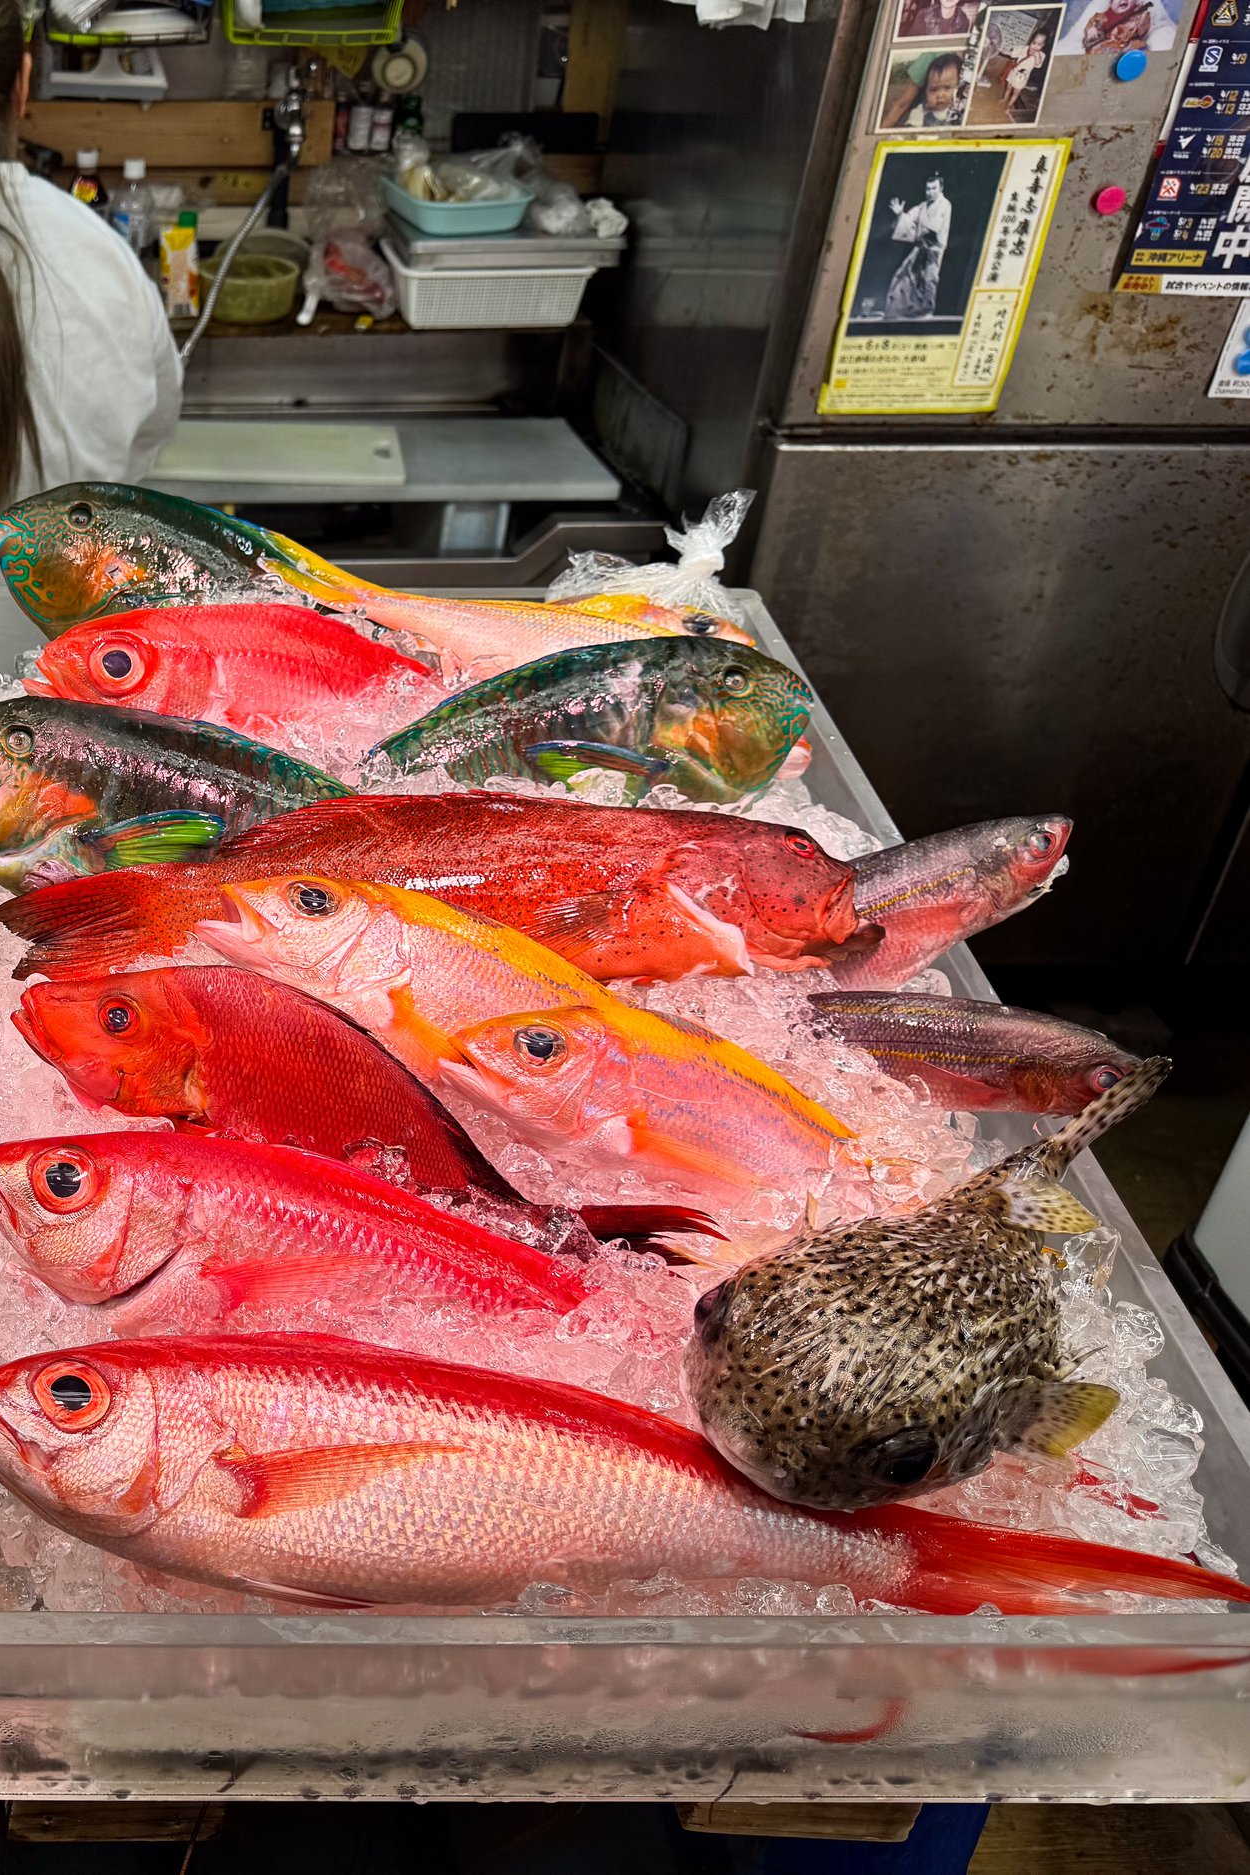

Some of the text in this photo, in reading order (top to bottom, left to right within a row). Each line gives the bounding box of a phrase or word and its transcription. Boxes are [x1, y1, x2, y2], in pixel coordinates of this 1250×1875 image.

[1165, 280, 1250, 291] 試合やイベントの情報
